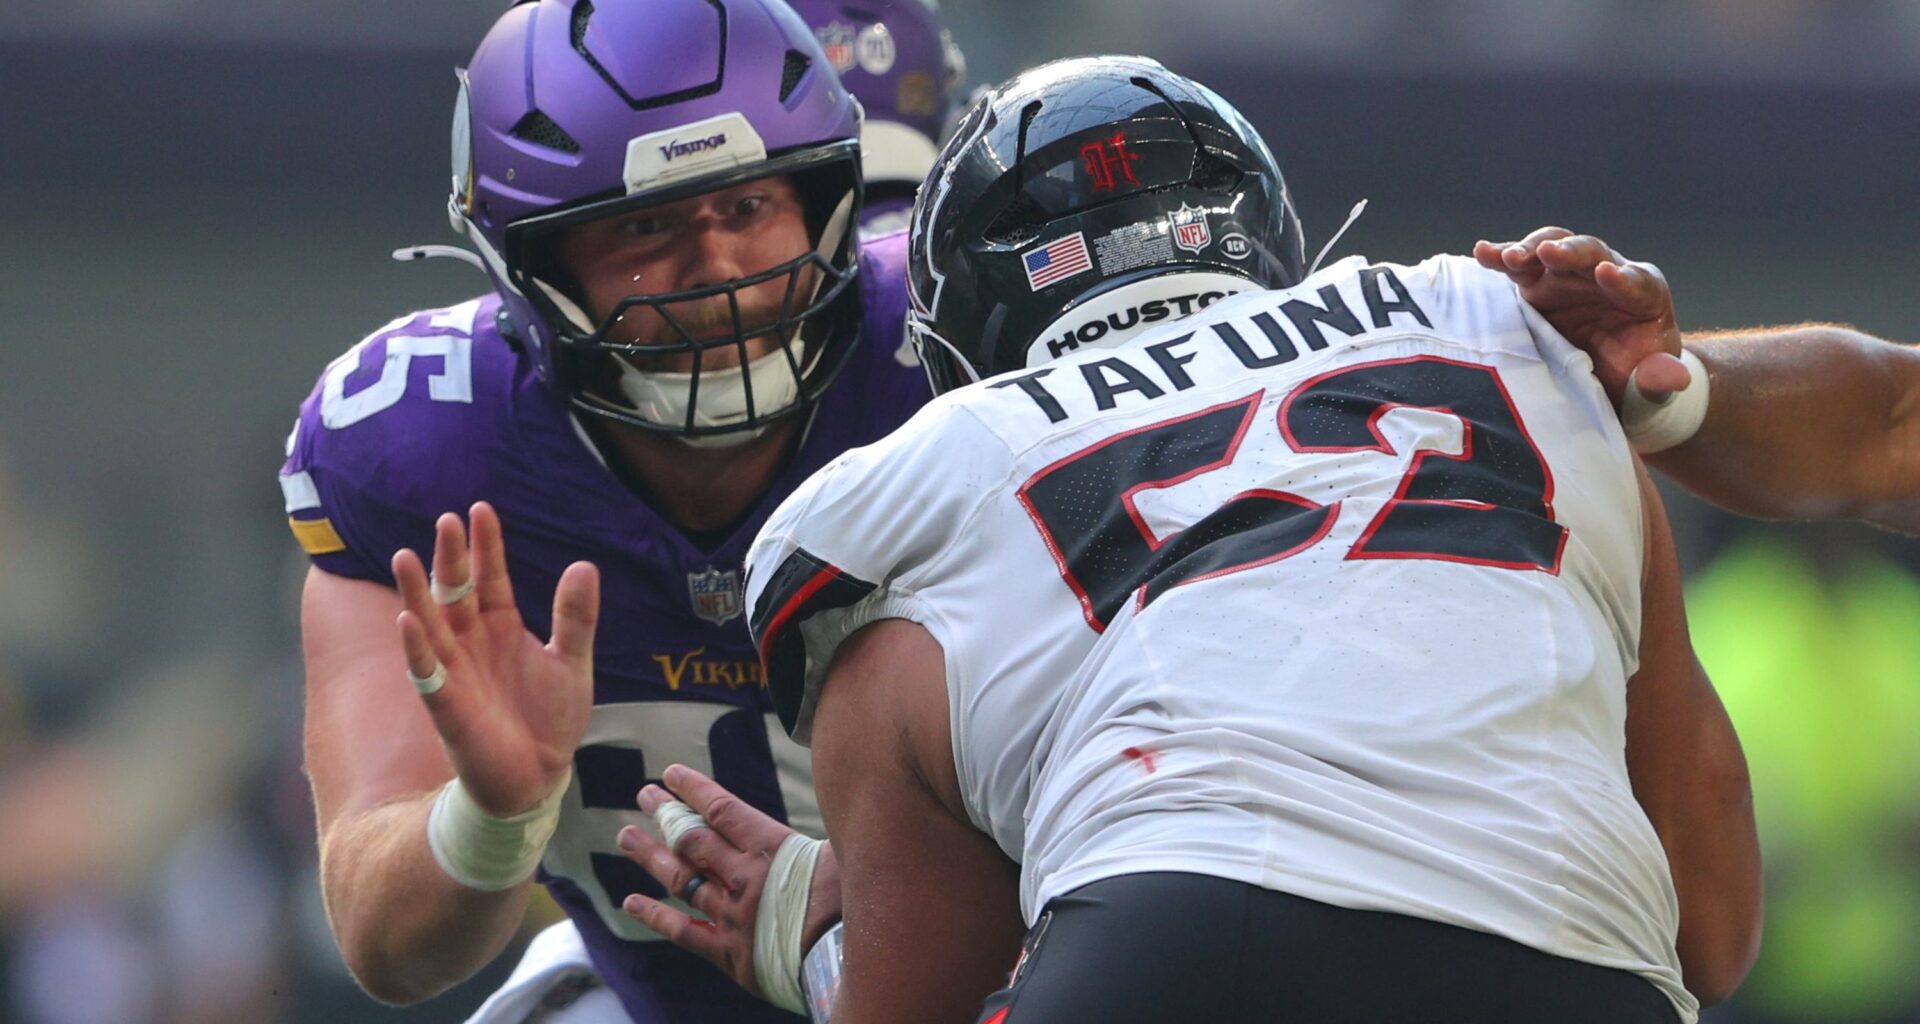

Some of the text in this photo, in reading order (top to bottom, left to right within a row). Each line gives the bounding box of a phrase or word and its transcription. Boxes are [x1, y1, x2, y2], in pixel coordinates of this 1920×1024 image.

[1179, 225, 1207, 246] NFL
[984, 266, 1435, 425] TAFUNA
[1047, 291, 1239, 359] HOUSTO
[1016, 353, 1570, 636] 52
[698, 593, 737, 614] NFL
